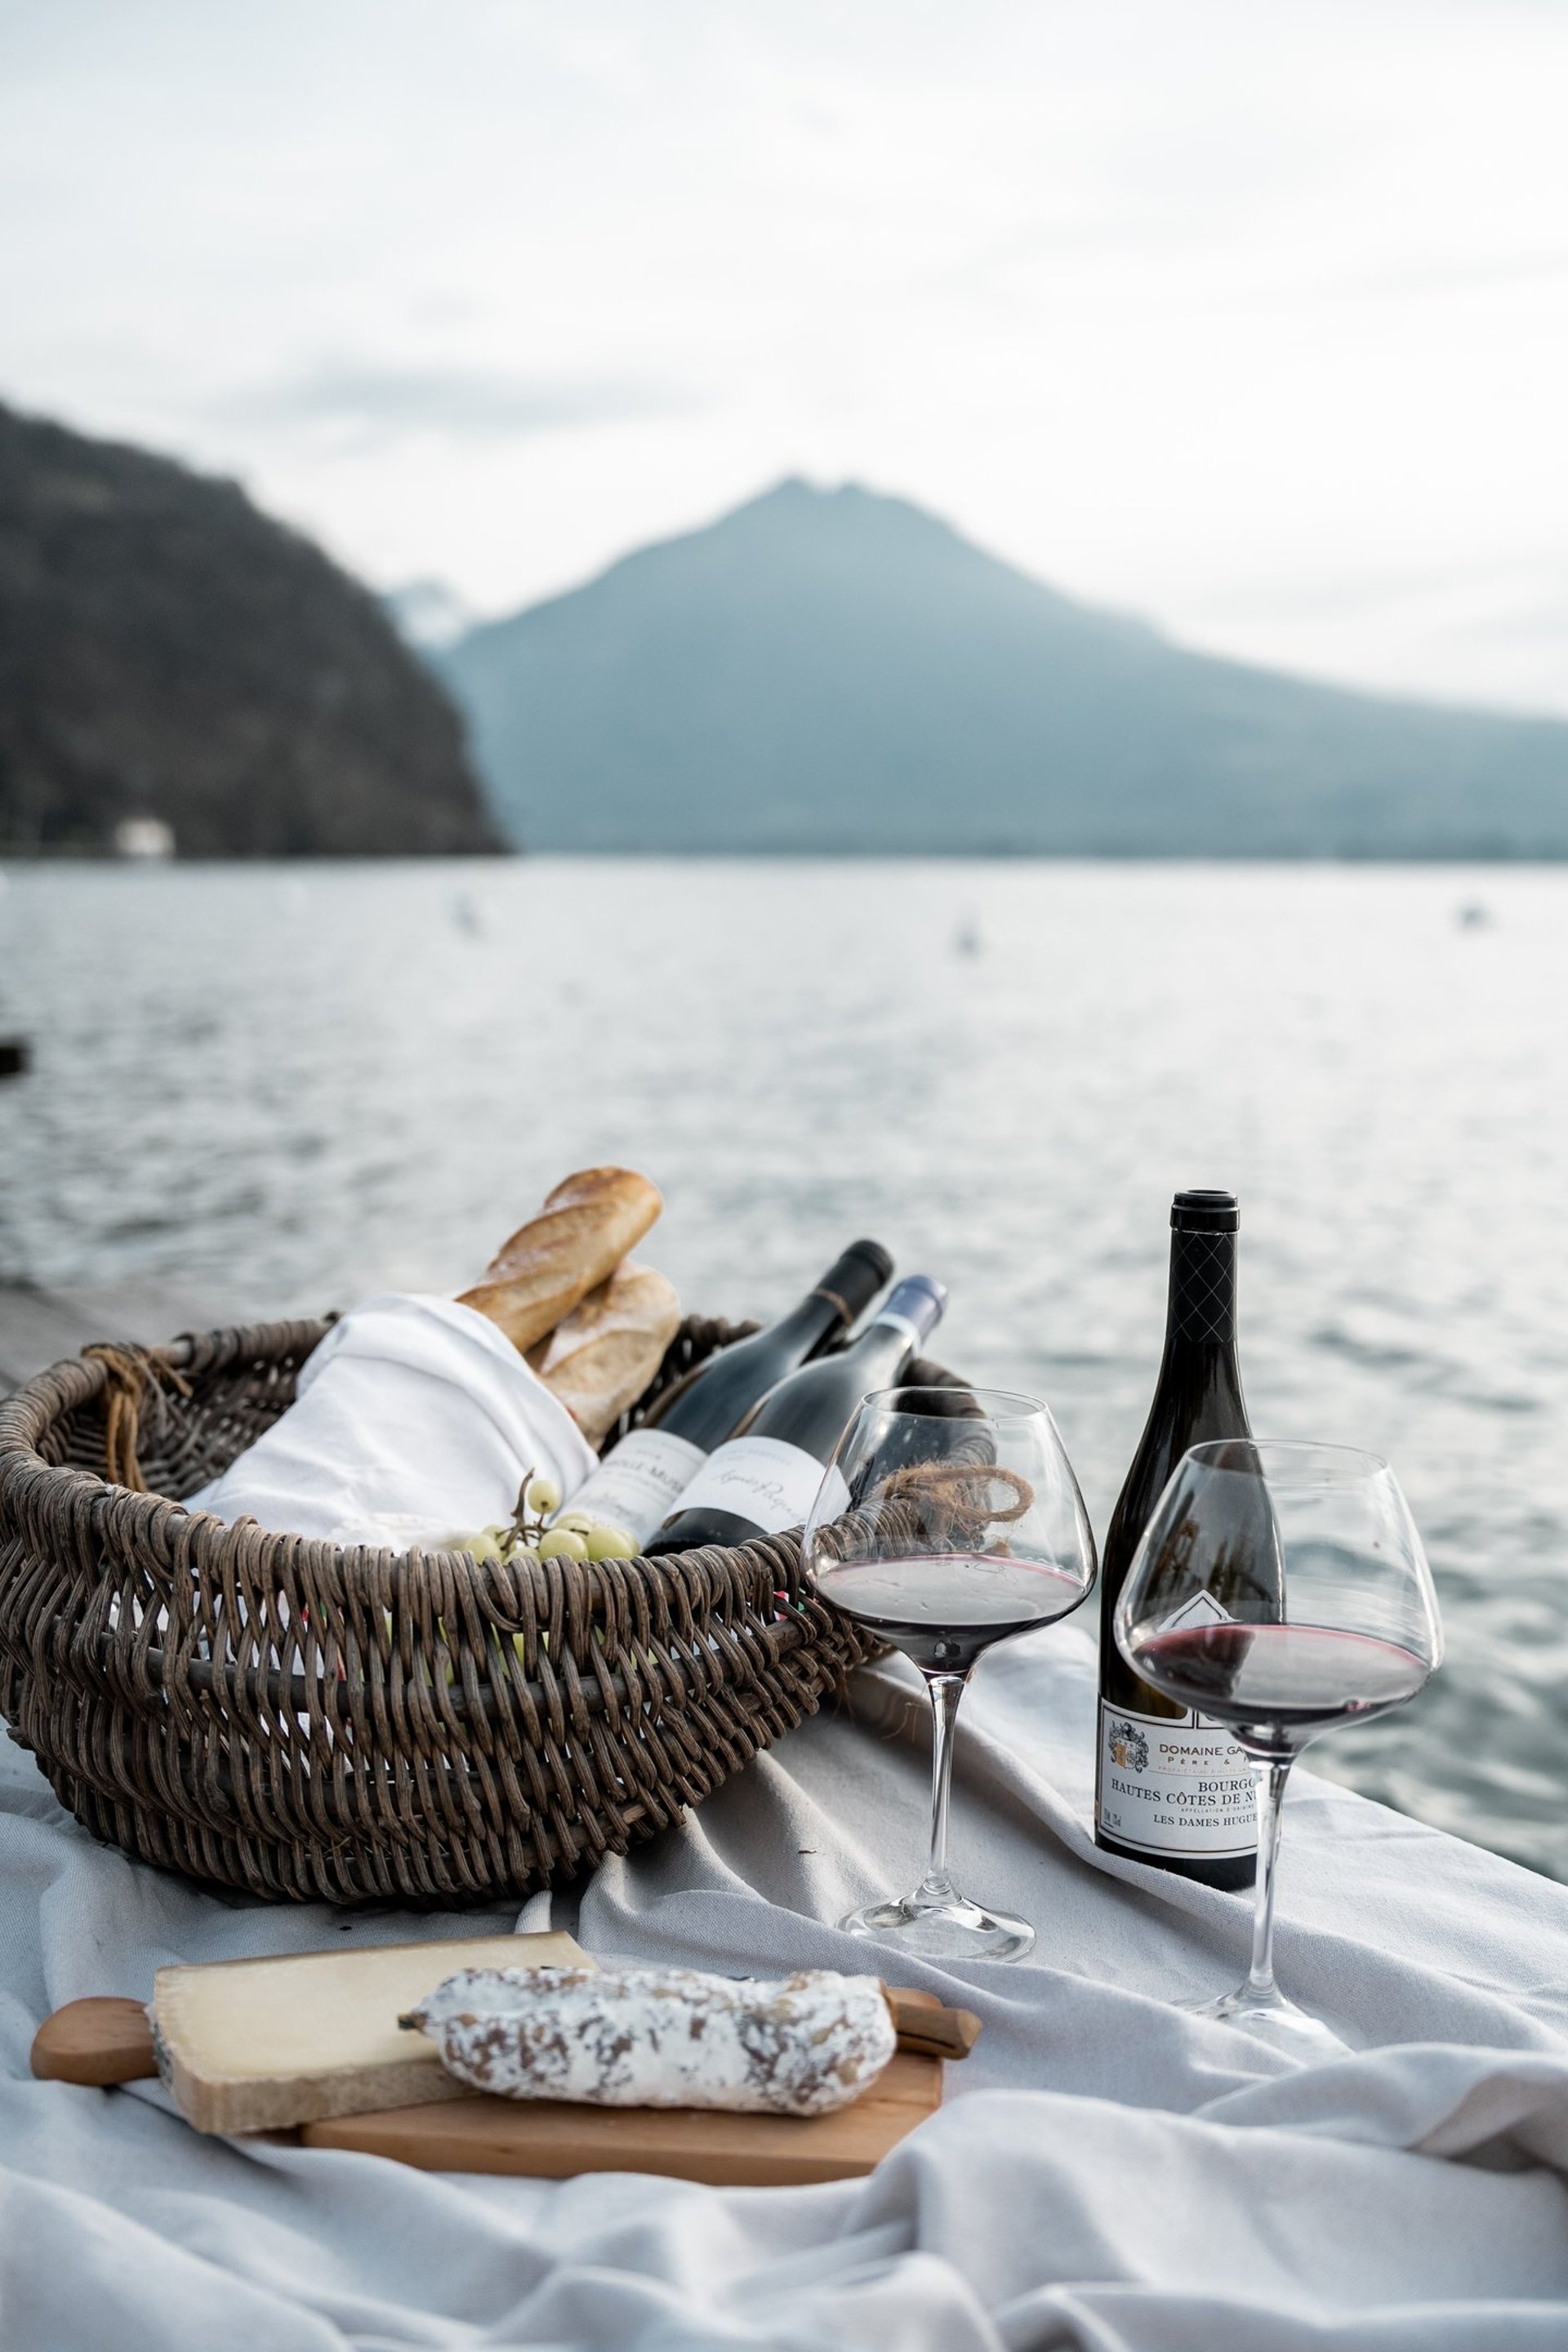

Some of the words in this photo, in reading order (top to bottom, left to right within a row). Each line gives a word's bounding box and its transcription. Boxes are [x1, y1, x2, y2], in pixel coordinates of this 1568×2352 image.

[1160, 1744, 1223, 1756] DOMAINE
[1111, 1778, 1161, 1802] HAUTES
[1166, 1792, 1216, 1806] CÔTES
[1222, 1793, 1241, 1805] DE
[1153, 1815, 1175, 1825] LES
[1179, 1817, 1219, 1827] DAMES
